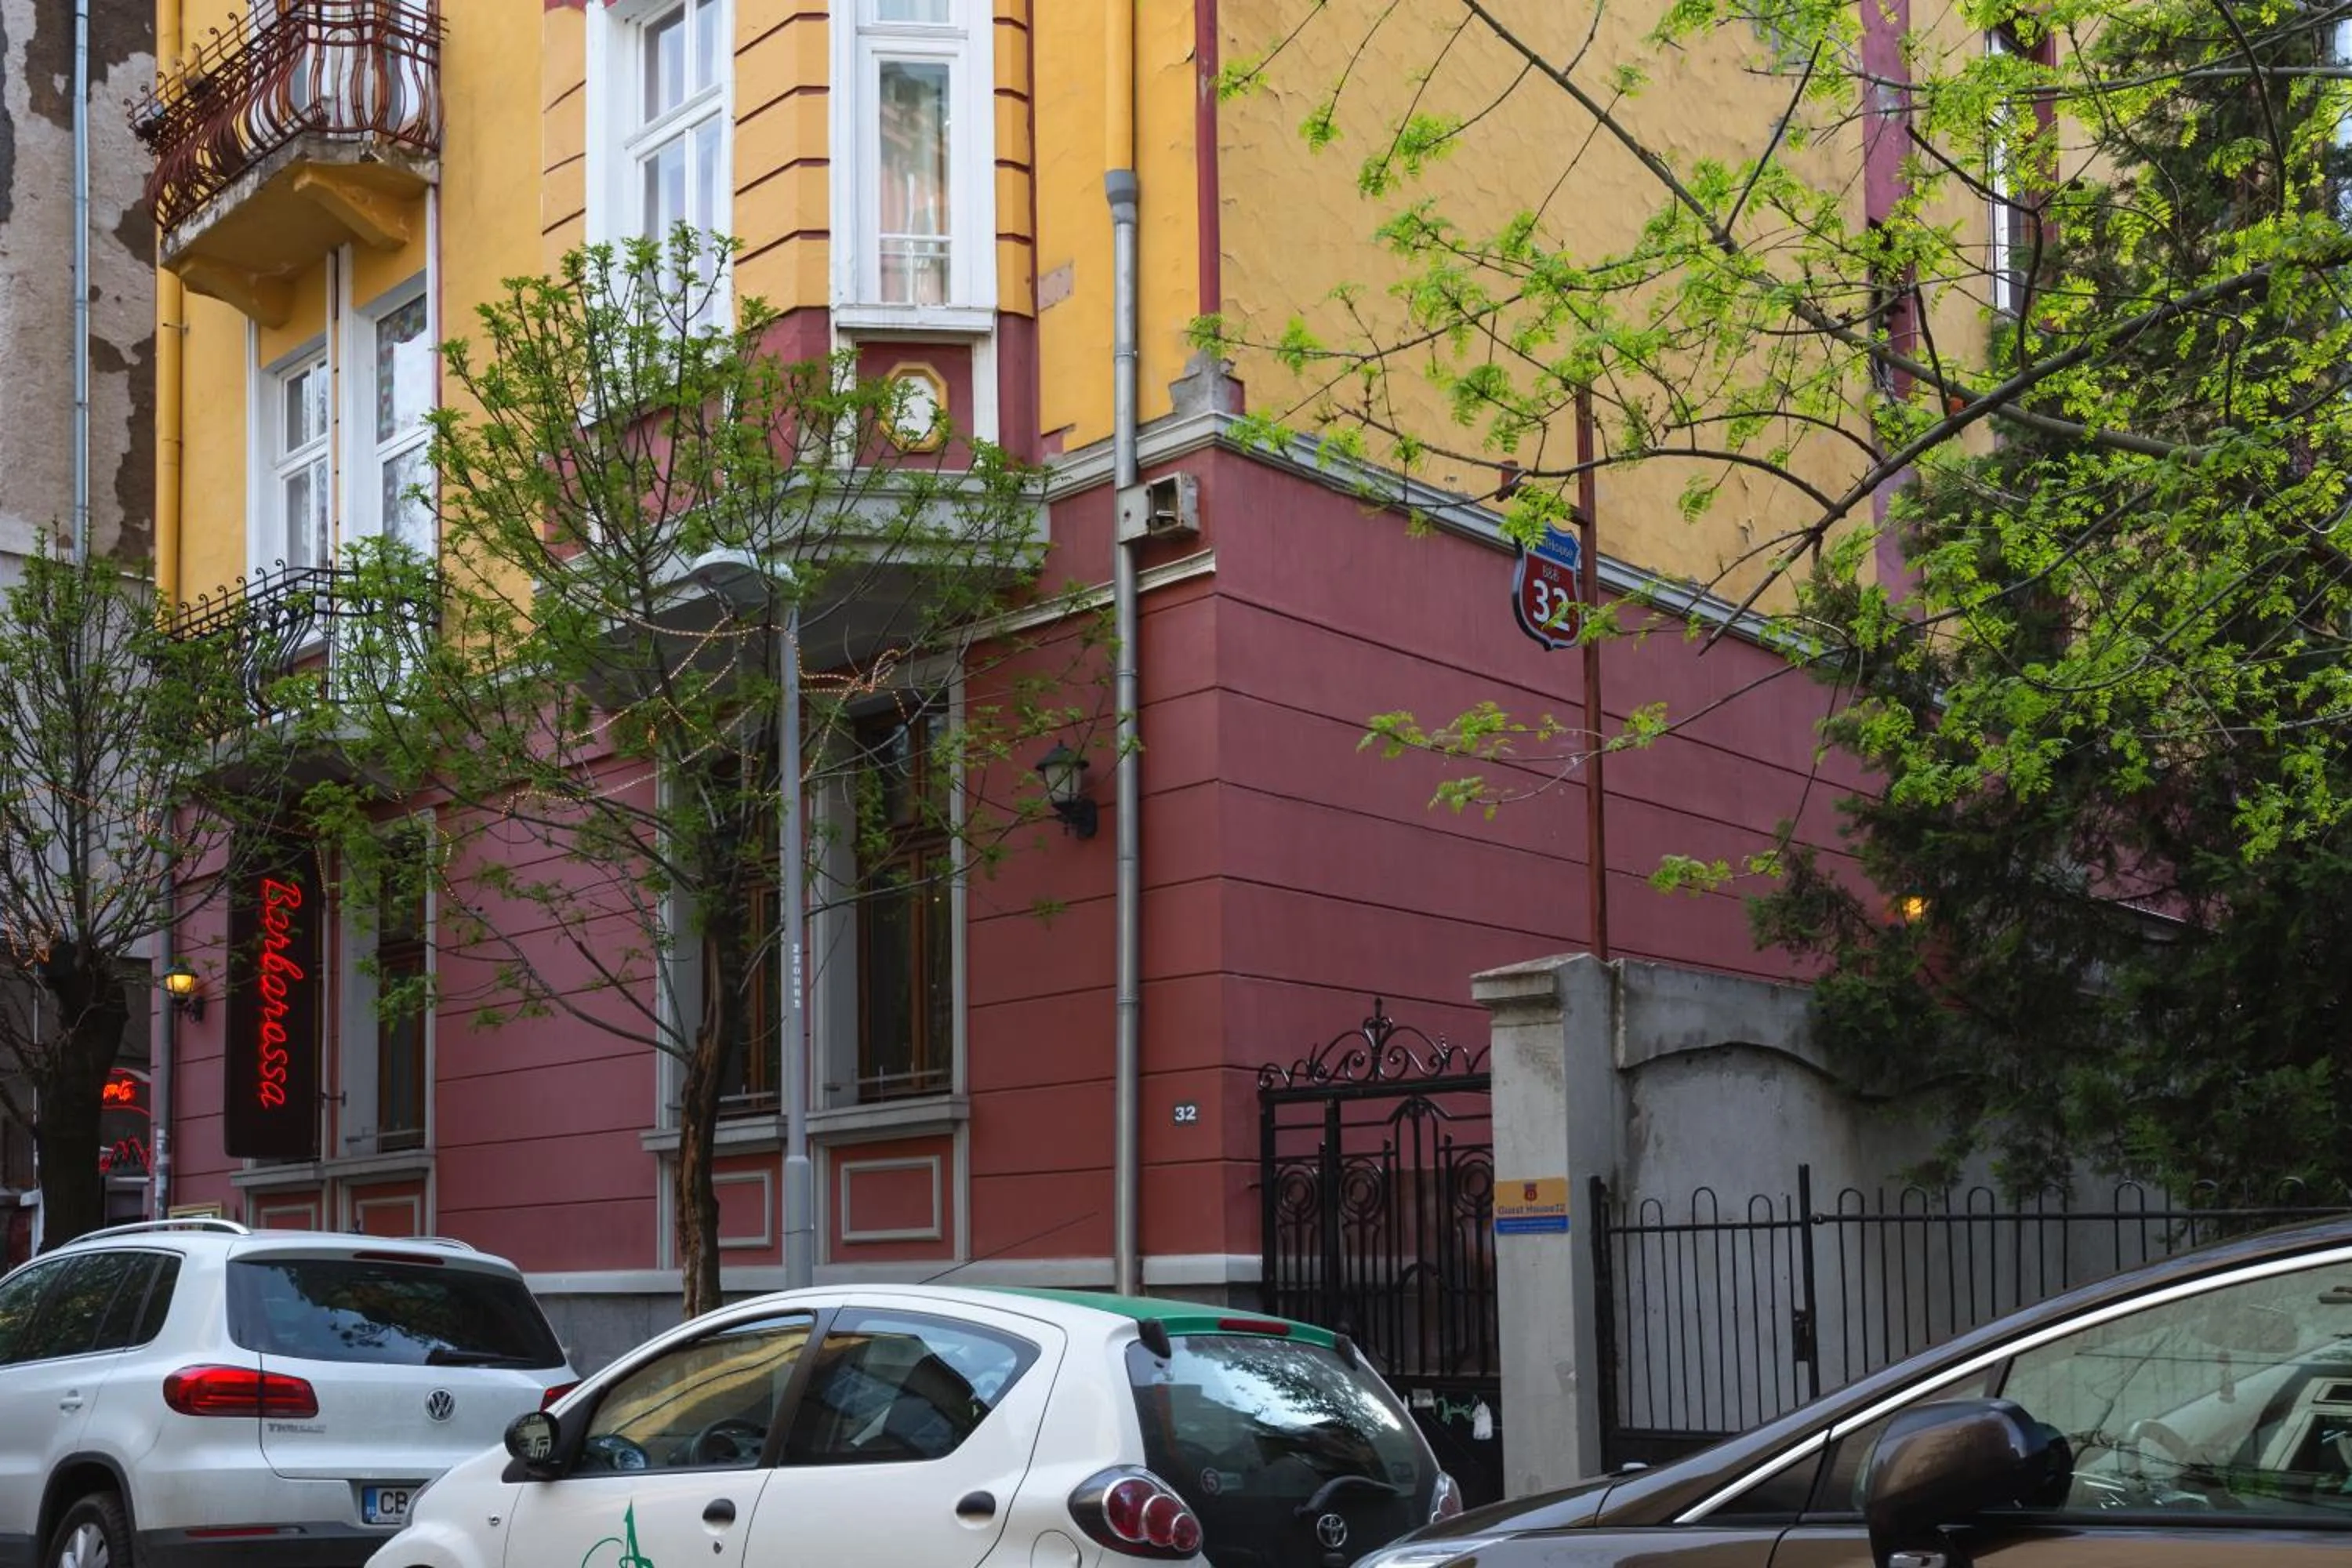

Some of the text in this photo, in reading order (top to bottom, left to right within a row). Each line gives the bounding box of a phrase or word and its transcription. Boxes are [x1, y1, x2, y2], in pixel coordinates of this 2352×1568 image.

[1533, 579, 1570, 631] 32
[261, 877, 304, 1109] Barbarossa
[1175, 1105, 1196, 1120] 32
[381, 1492, 408, 1514] CB
